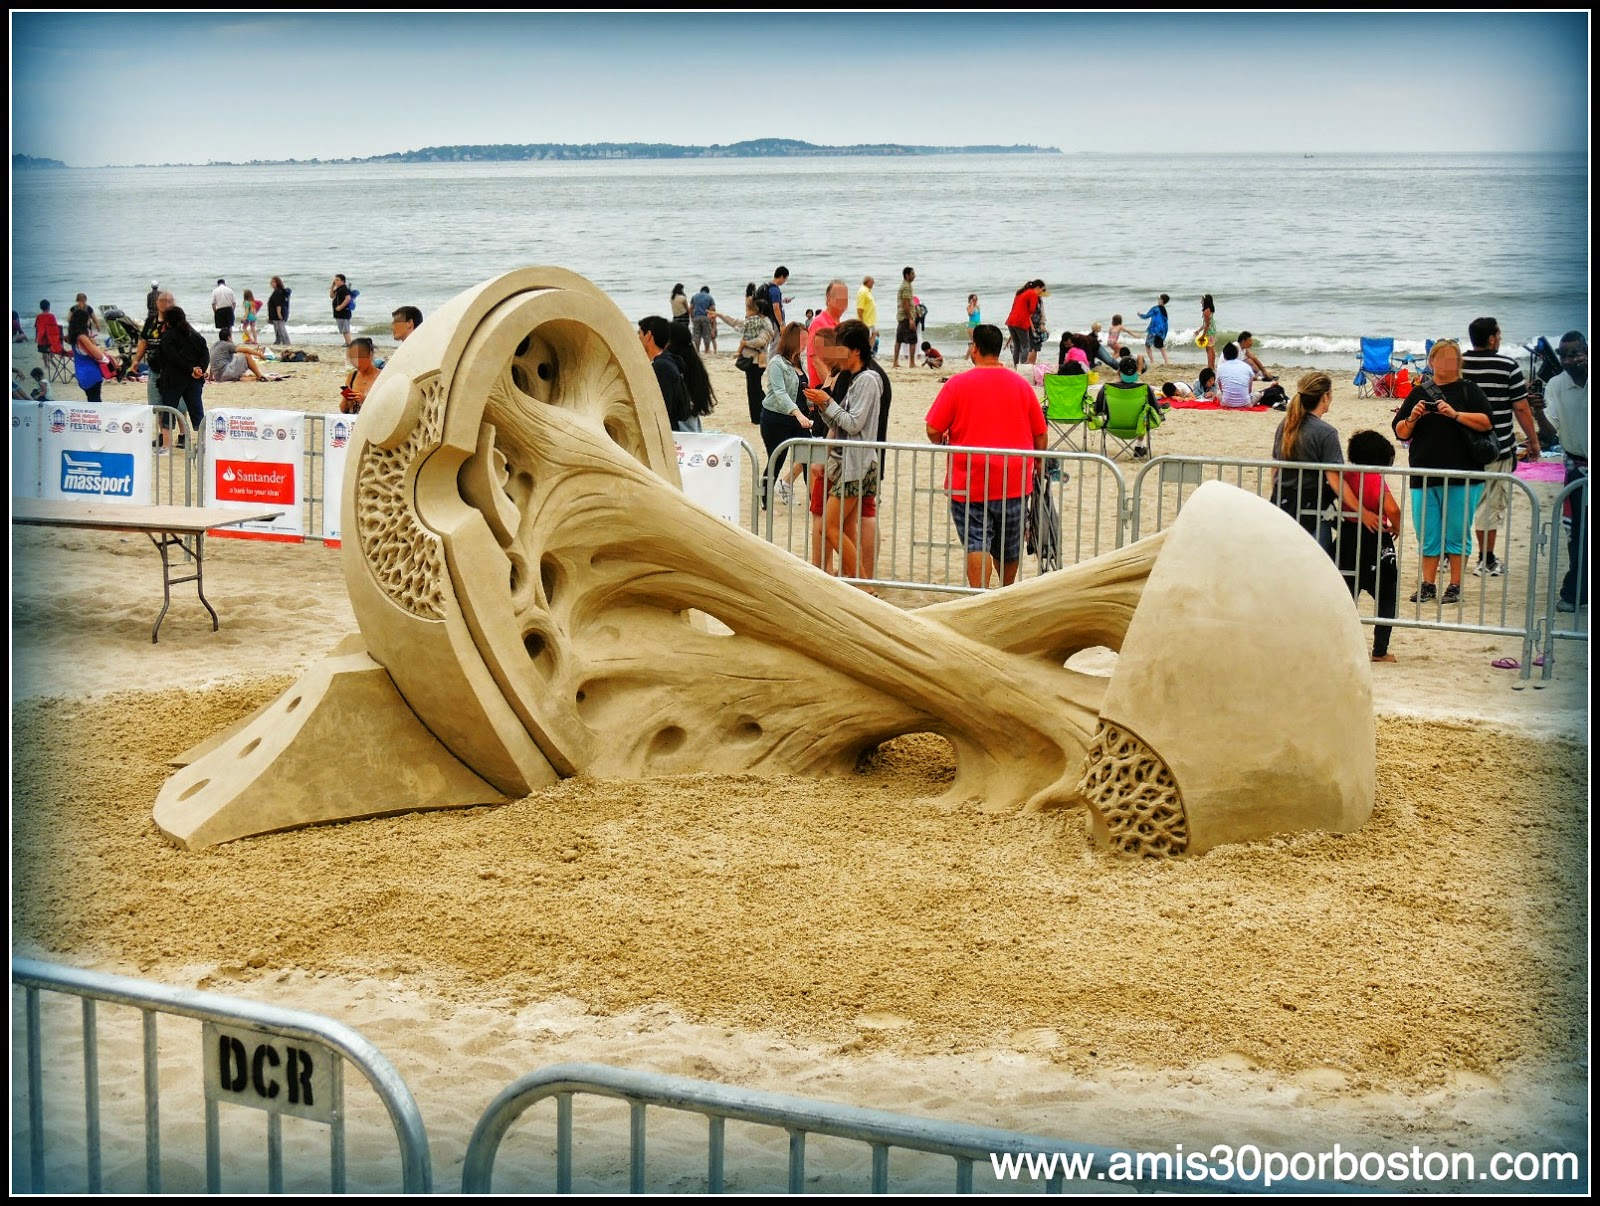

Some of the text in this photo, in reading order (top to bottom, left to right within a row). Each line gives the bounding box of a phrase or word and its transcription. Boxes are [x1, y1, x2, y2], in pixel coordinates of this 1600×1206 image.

[70, 423, 102, 431] FESTIVAL
[230, 430, 258, 438] FESTIVAL
[237, 469, 285, 484] Santander
[63, 474, 131, 495] massport
[219, 1034, 314, 1106] DCR
